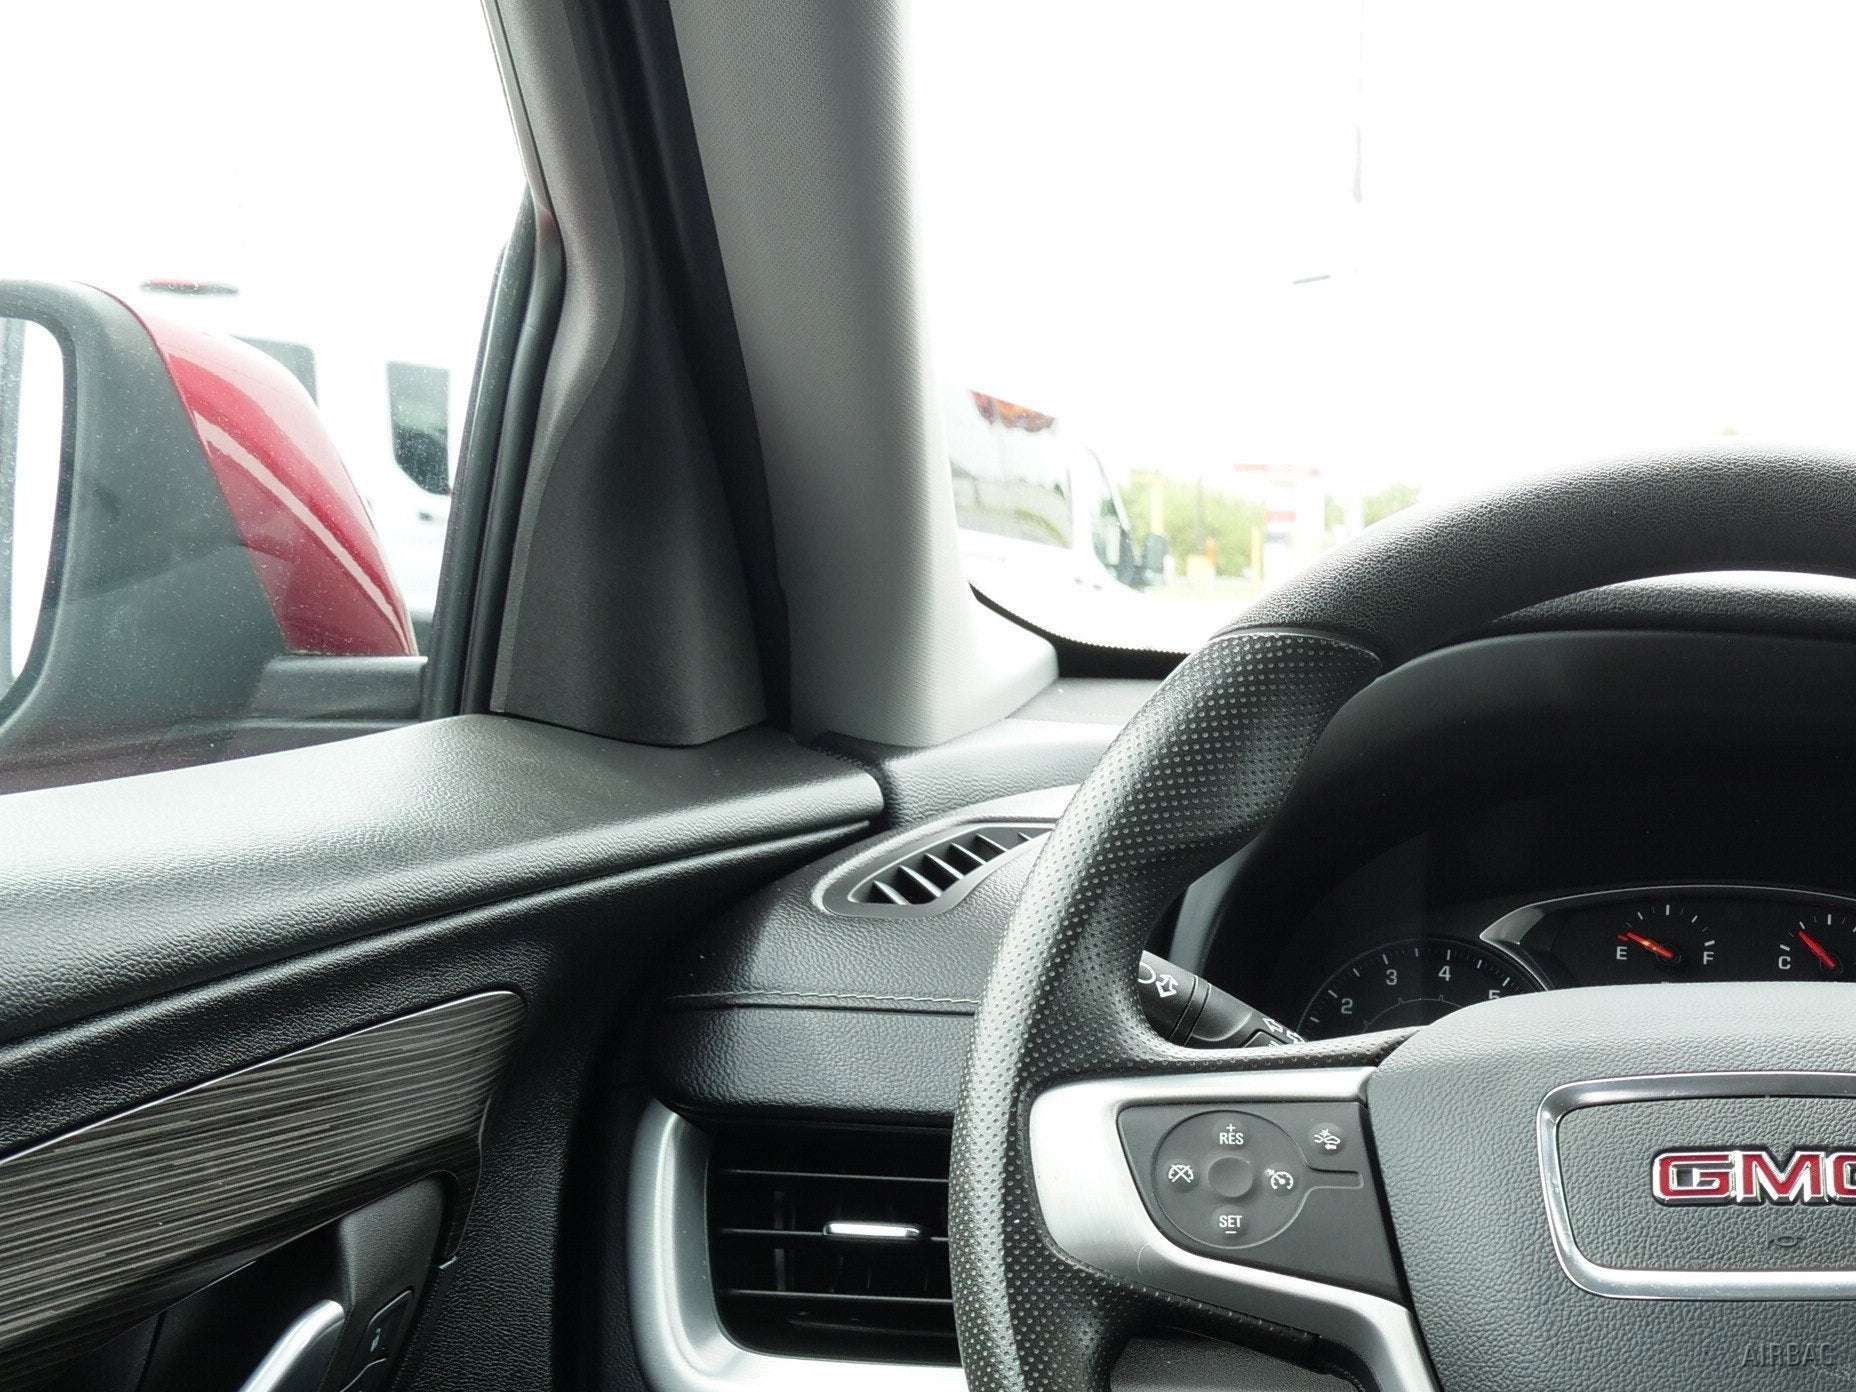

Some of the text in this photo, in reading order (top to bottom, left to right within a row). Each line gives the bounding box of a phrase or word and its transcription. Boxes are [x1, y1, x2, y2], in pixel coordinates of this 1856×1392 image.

[1615, 945, 1628, 961] E
[1702, 951, 1715, 965] F
[1778, 955, 1792, 970] C
[1385, 968, 1398, 986] 3
[1438, 964, 1451, 982] 4
[1340, 997, 1353, 1015] 2
[1218, 1130, 1244, 1146] RES
[1218, 1214, 1243, 1229] SET
[1740, 1342, 1836, 1369] AIRBAG
